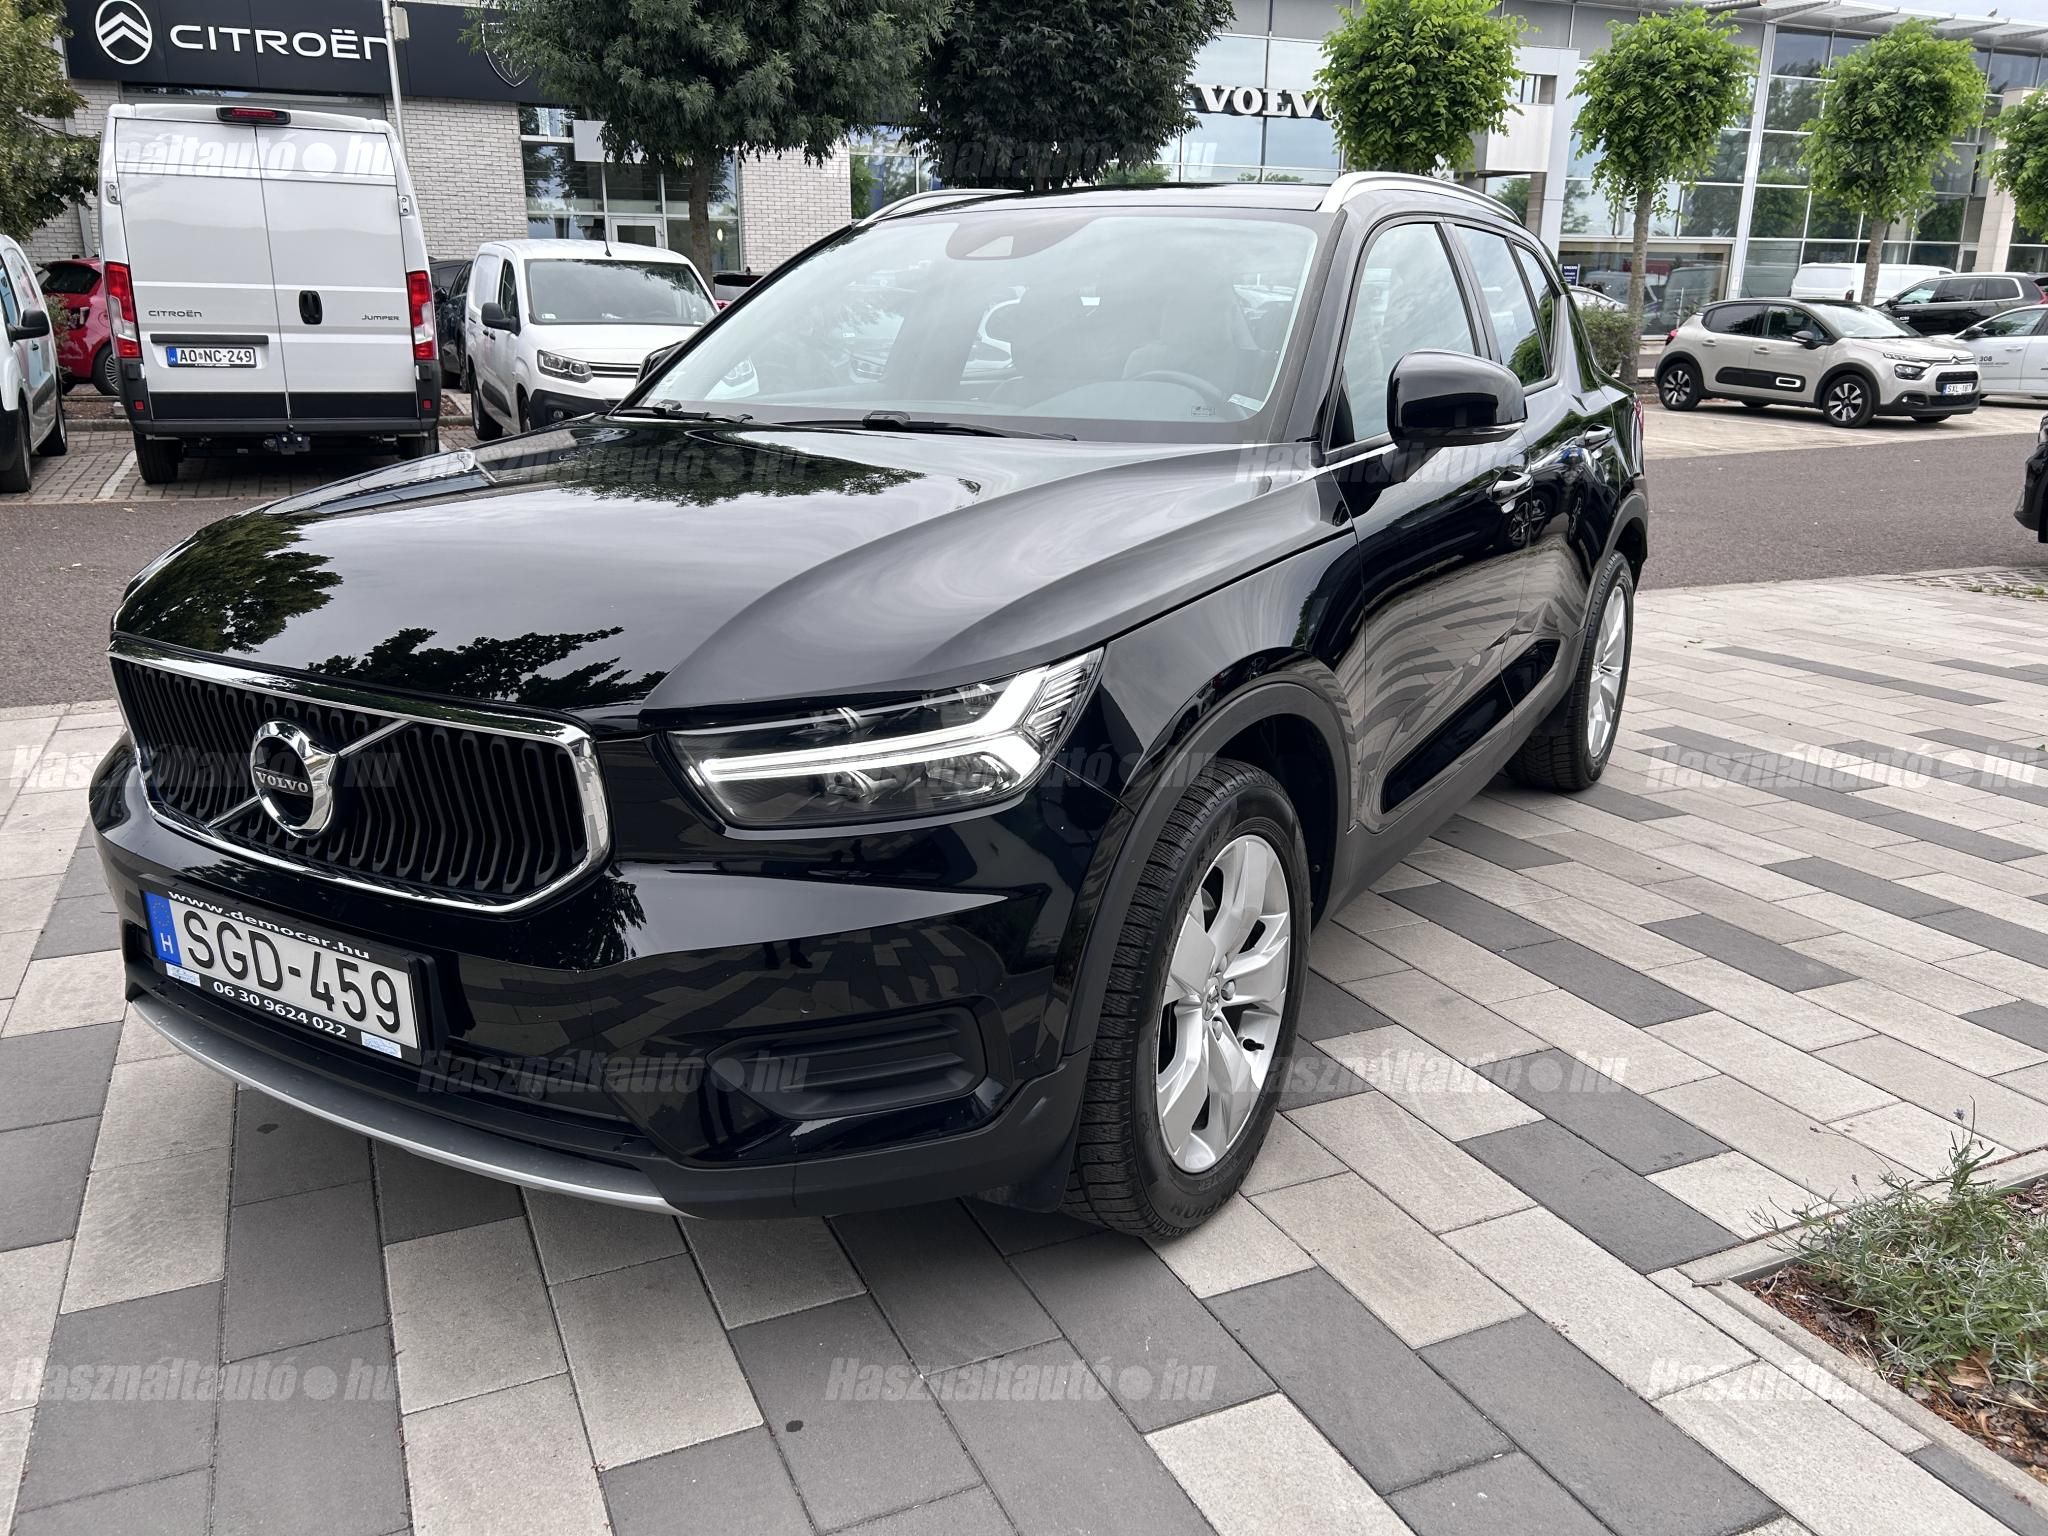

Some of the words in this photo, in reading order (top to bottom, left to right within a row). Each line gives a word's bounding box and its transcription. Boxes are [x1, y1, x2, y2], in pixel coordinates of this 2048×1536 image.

[255, 770, 309, 793] VOLVO
[167, 890, 371, 961] www.democar.hu
[183, 910, 401, 1034] SGD-459
[213, 981, 235, 998] 06
[239, 990, 261, 1007] 30
[264, 1000, 309, 1024] 9624
[312, 1016, 348, 1039] 022
